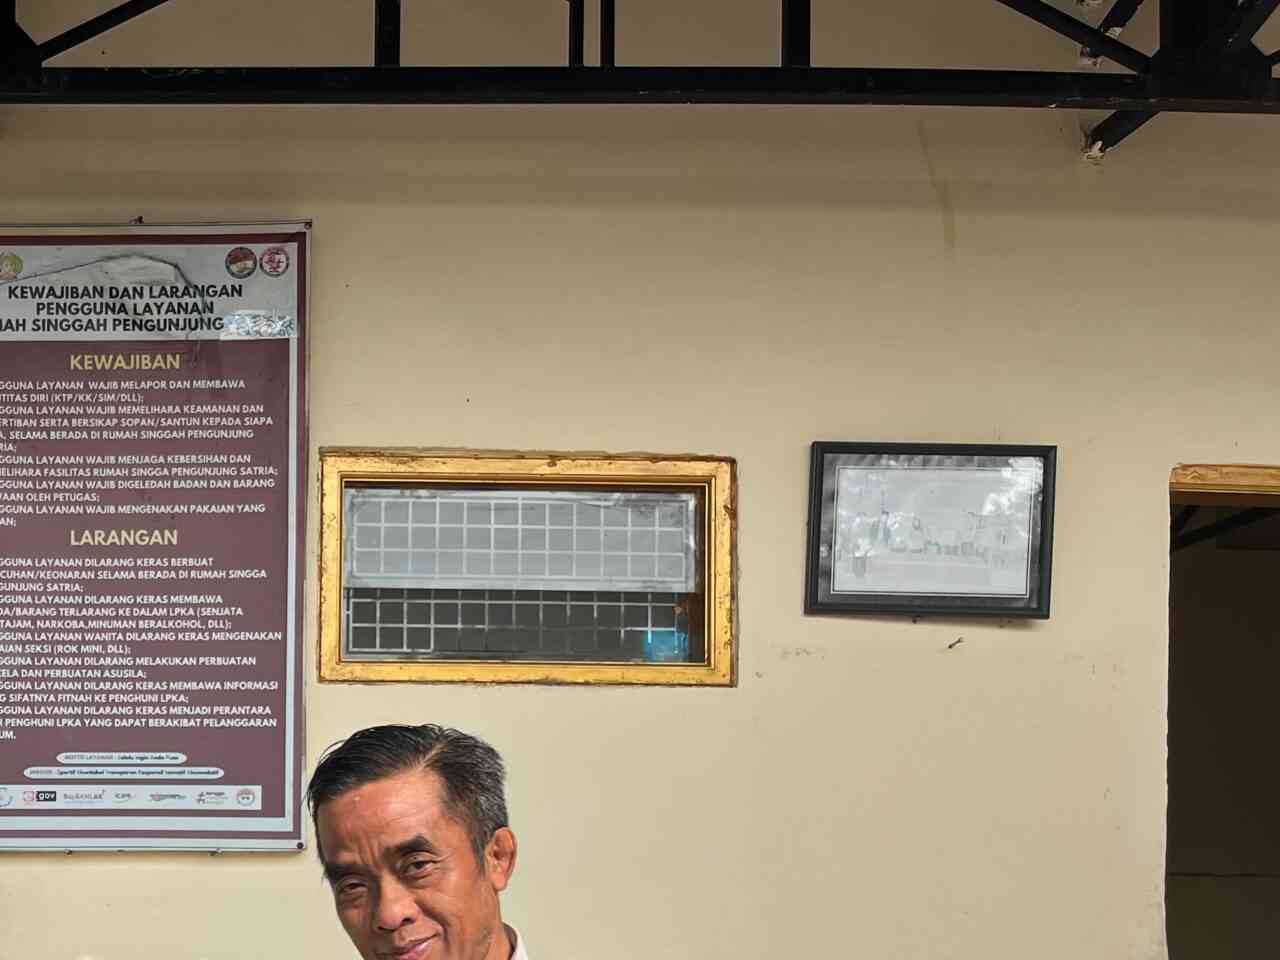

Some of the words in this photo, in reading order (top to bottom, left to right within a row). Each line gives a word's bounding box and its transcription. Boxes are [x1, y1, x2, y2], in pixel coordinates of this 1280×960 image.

[8, 285, 104, 299] KEWAJIBAN
[108, 285, 144, 300] DAN
[148, 283, 242, 298] LARANGAN
[35, 301, 129, 315] PENGGUNA
[132, 301, 214, 315] LAYANAN
[31, 318, 107, 332] SINGGAH
[112, 317, 224, 331] PENGUNJUNG
[70, 354, 180, 370] KEWAJIBAN
[35, 381, 84, 389] LAYANAN
[87, 381, 119, 389] WAJIB
[120, 380, 167, 389] MELAPOR
[168, 380, 191, 389] DAN
[192, 379, 245, 388] MEMBAWA
[29, 393, 49, 402] DIRI
[35, 405, 83, 414] LAYANAN
[85, 405, 116, 414] WAJIB
[117, 405, 181, 414] MEMELIHARA
[183, 404, 240, 413] KEAMANAN
[241, 404, 263, 413] DAN
[39, 418, 69, 427] SERTA
[71, 417, 118, 427] BERSIKAP
[119, 417, 200, 426] SOPAN/SANTUN
[202, 416, 241, 425] KEPADA
[243, 416, 273, 425] SIAPA
[9, 430, 48, 439] SELAMA
[49, 430, 88, 439] BERADA
[90, 430, 100, 439] DI
[102, 430, 138, 439] RUMAH
[140, 430, 185, 439] SINGGAH
[187, 429, 254, 438] PENGUNJUNG
[35, 455, 83, 464] LAYANAN
[85, 455, 116, 464] WAJIB
[117, 455, 165, 464] MENJAGA
[167, 454, 227, 463] KEBERSIHAN
[229, 454, 251, 463] DAN
[43, 467, 91, 476] FASILITAS
[92, 467, 128, 476] RUMAH
[130, 467, 169, 476] SINGGA
[170, 466, 237, 476] PENGUNJUNG
[35, 480, 83, 489] LAYANAN
[85, 480, 116, 489] WAJIB
[117, 479, 171, 488] DIGELEDAH
[172, 479, 207, 488] BADAN
[209, 479, 231, 488] DAN
[232, 478, 275, 488] BARANG
[25, 492, 51, 501] OLEH
[35, 505, 83, 514] LAYANAN
[85, 505, 116, 514] WAJIB
[117, 504, 188, 514] MENGENAKAN
[189, 504, 234, 513] PAKAIAN
[236, 503, 266, 512] YANG
[70, 529, 178, 545] LARANGAN
[34, 558, 82, 567] LAYANAN
[84, 557, 135, 567] DILARANG
[136, 557, 168, 567] KERAS
[170, 557, 213, 566] BERBUAT
[97, 570, 136, 579] SELAMA
[137, 570, 176, 579] BERADA
[178, 569, 188, 579] DI
[190, 569, 226, 579] RUMAH
[228, 569, 267, 578] SINGGA
[34, 595, 82, 604] LAYANAN
[84, 594, 134, 604] DILARANG
[136, 594, 168, 604] KERAS
[169, 594, 223, 603] MEMBAWA
[58, 607, 116, 616] TERLARANG
[132, 607, 167, 616] DALAM
[169, 607, 195, 616] LPKA
[196, 606, 243, 616] (SENJATA
[34, 632, 82, 641] LAYANAN
[83, 632, 124, 641] WANITA
[125, 631, 176, 641] DILARANG
[177, 631, 210, 641] KERAS
[211, 631, 282, 640] MENGENAKAN
[23, 644, 51, 653] SEKSI
[53, 644, 78, 653] (ROK
[34, 656, 82, 665] LAYANAN
[83, 656, 134, 666] DILARANG
[135, 656, 197, 666] MELAKUKAN
[198, 656, 256, 665] PERBUATAN
[20, 668, 42, 677] DAN
[43, 668, 101, 678] PERBUATAN
[34, 681, 82, 690] LAYANAN
[83, 681, 134, 690] DILARANG
[135, 681, 168, 690] KERAS
[168, 681, 222, 690] MEMBAWA
[223, 680, 278, 690] INFORMASI
[8, 693, 56, 702] SIFATNYA
[57, 693, 92, 702] FITNAH
[93, 693, 107, 702] KE
[108, 693, 158, 702] PENGHUNI
[33, 705, 82, 715] LAYANAN
[83, 705, 133, 715] DILARANG
[135, 705, 167, 715] KERAS
[168, 705, 211, 714] MENJADI
[212, 705, 271, 715] PERANTARA
[4, 717, 54, 727] PENGHUNI
[56, 717, 81, 727] LPKA
[83, 718, 112, 727] YANG
[114, 718, 146, 727] DAPAT
[148, 718, 201, 727] BERAKIBAT
[202, 717, 277, 727] PELANGGARAN
